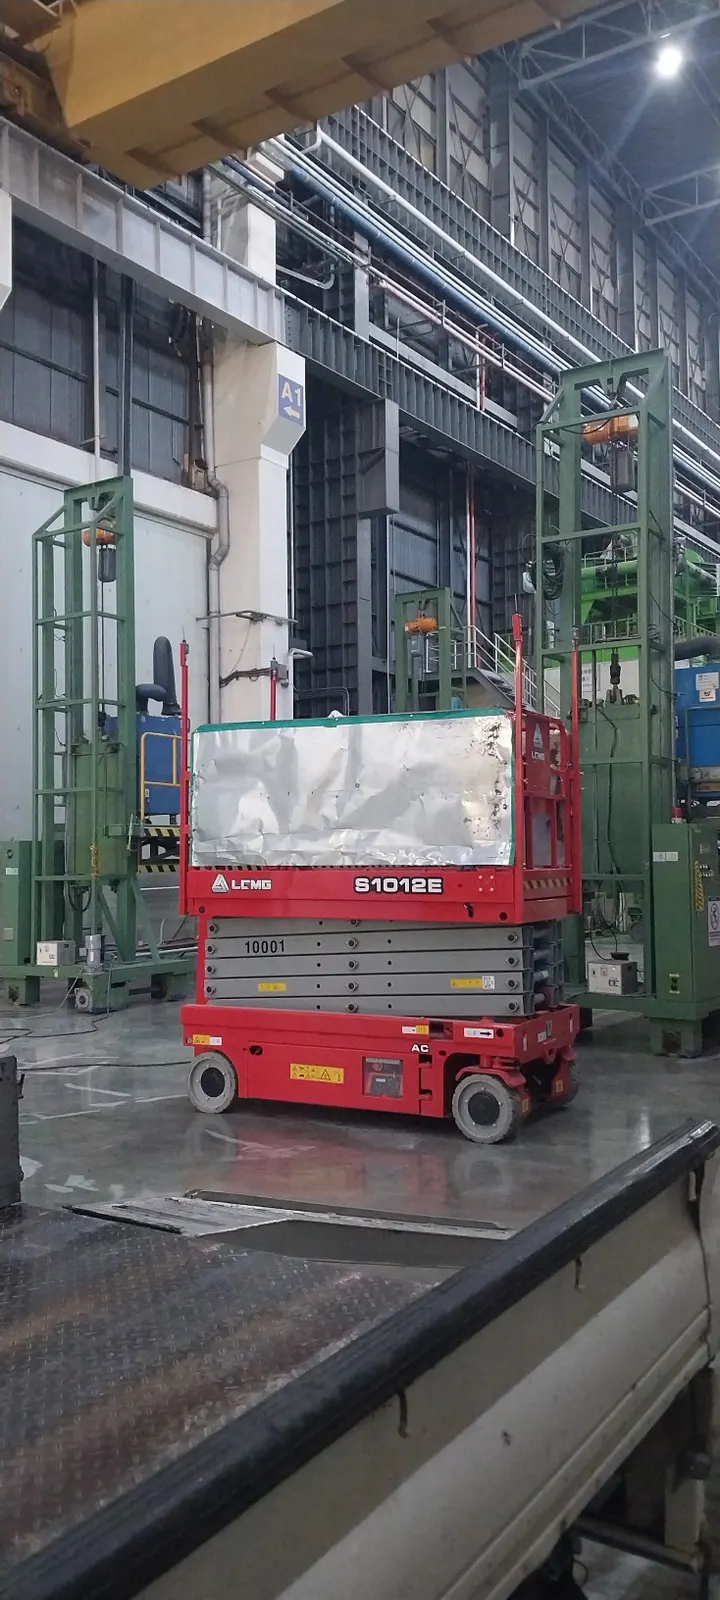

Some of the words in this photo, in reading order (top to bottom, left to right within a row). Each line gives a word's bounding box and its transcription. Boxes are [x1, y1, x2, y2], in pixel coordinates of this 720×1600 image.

[281, 381, 301, 407] A1
[354, 877, 443, 893] S1012E
[245, 940, 285, 954] 10001
[411, 1043, 429, 1053] AC
